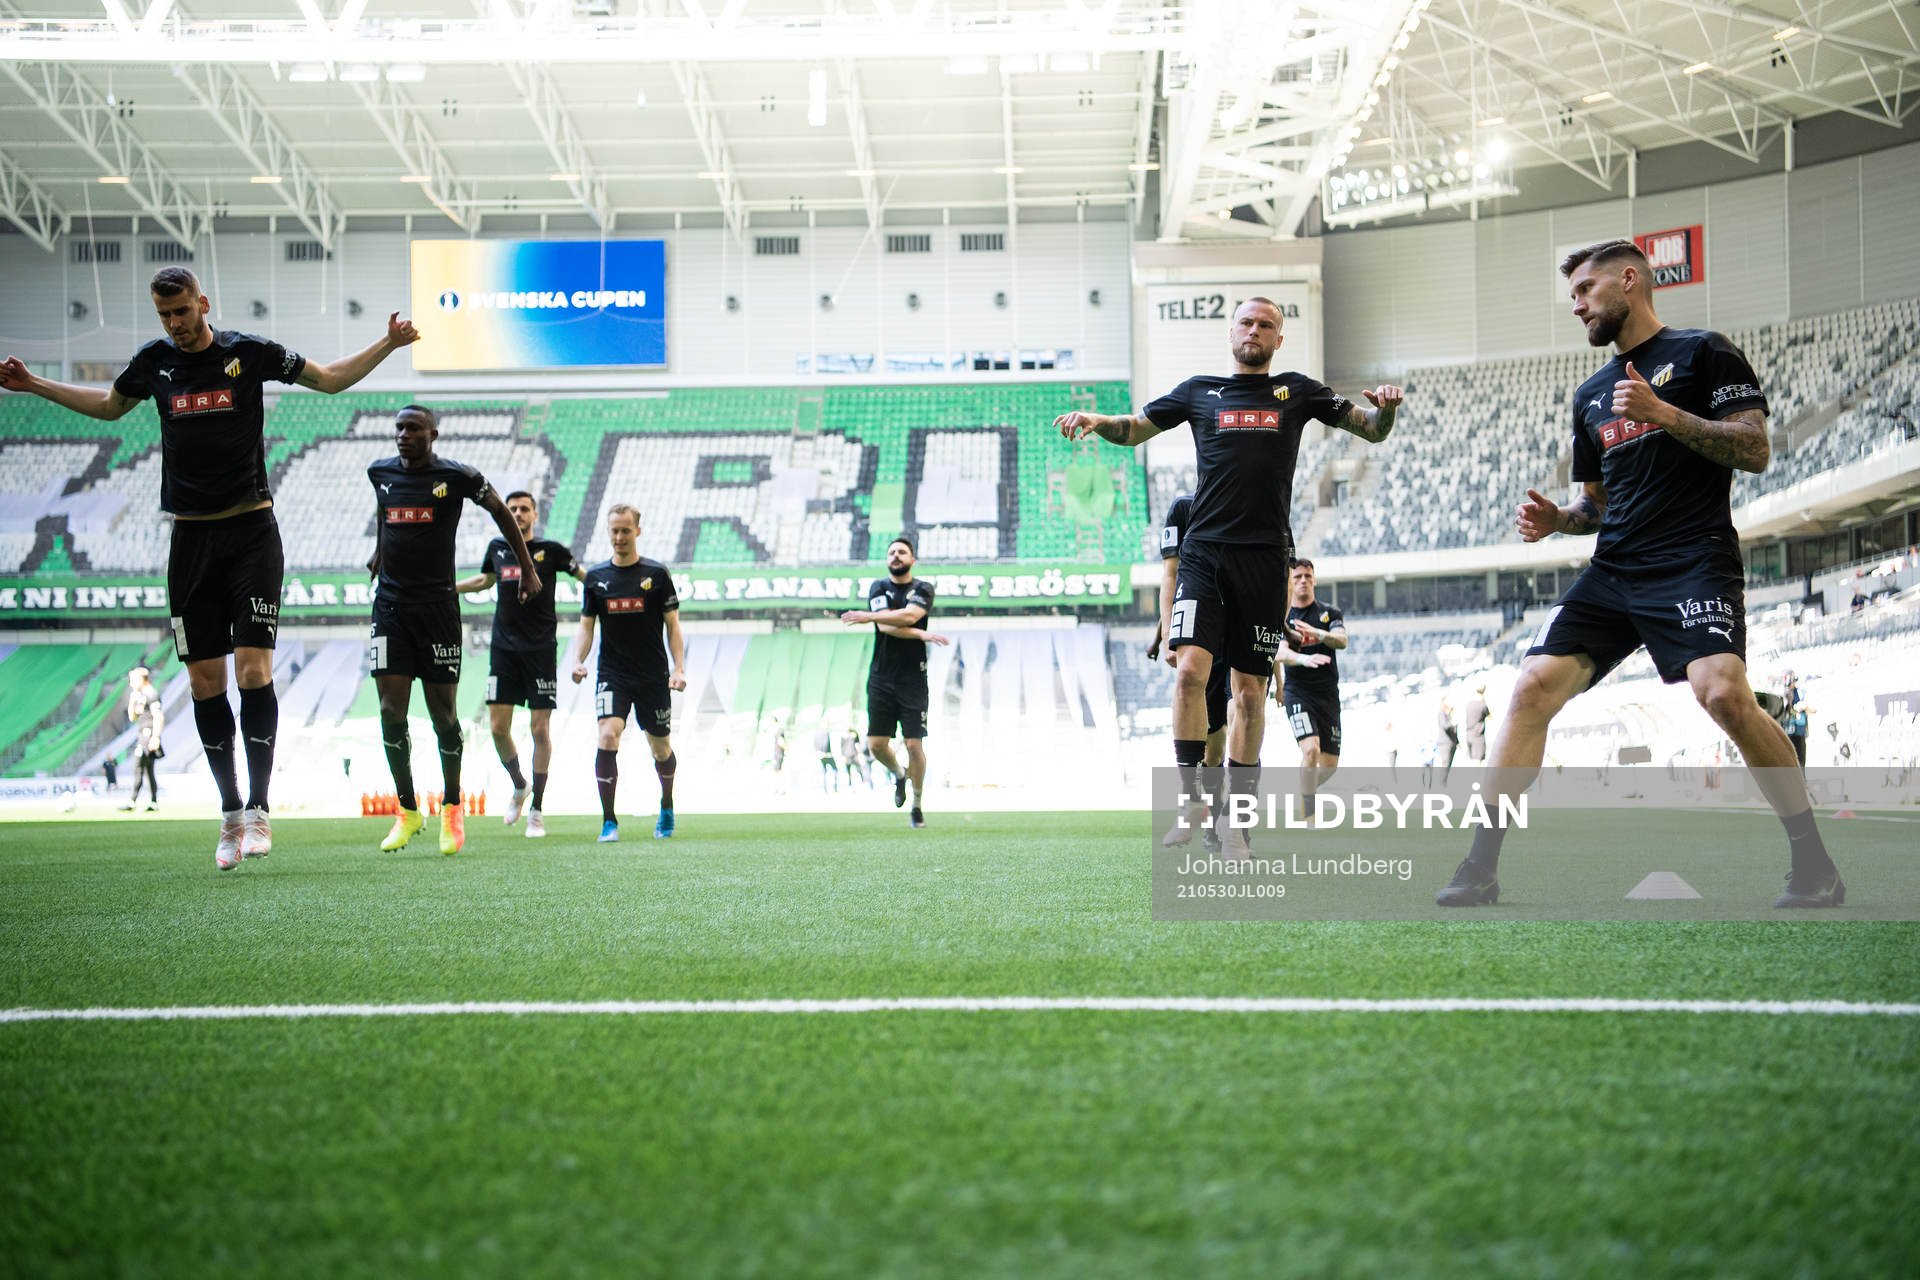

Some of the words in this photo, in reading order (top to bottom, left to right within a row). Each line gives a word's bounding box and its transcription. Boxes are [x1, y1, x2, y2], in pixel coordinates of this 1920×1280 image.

[1648, 234, 1685, 268] JOB
[470, 291, 568, 309] SVENSKA
[571, 290, 645, 308] CUPEN
[1157, 294, 1225, 320] TELE2
[1712, 383, 1752, 398] NORDIC
[176, 394, 230, 409] BRA
[1223, 414, 1277, 424] BRA
[1603, 419, 1650, 442] BR
[390, 511, 431, 520] BRA
[23, 587, 68, 608] NI
[75, 586, 167, 608] INTE
[281, 578, 338, 605] ÅR
[671, 574, 721, 600] ÖR
[725, 576, 851, 600] FANAN
[989, 568, 1121, 597] BRÖST!
[1675, 596, 1733, 619] Varis
[1681, 614, 1735, 629] Förvaltning
